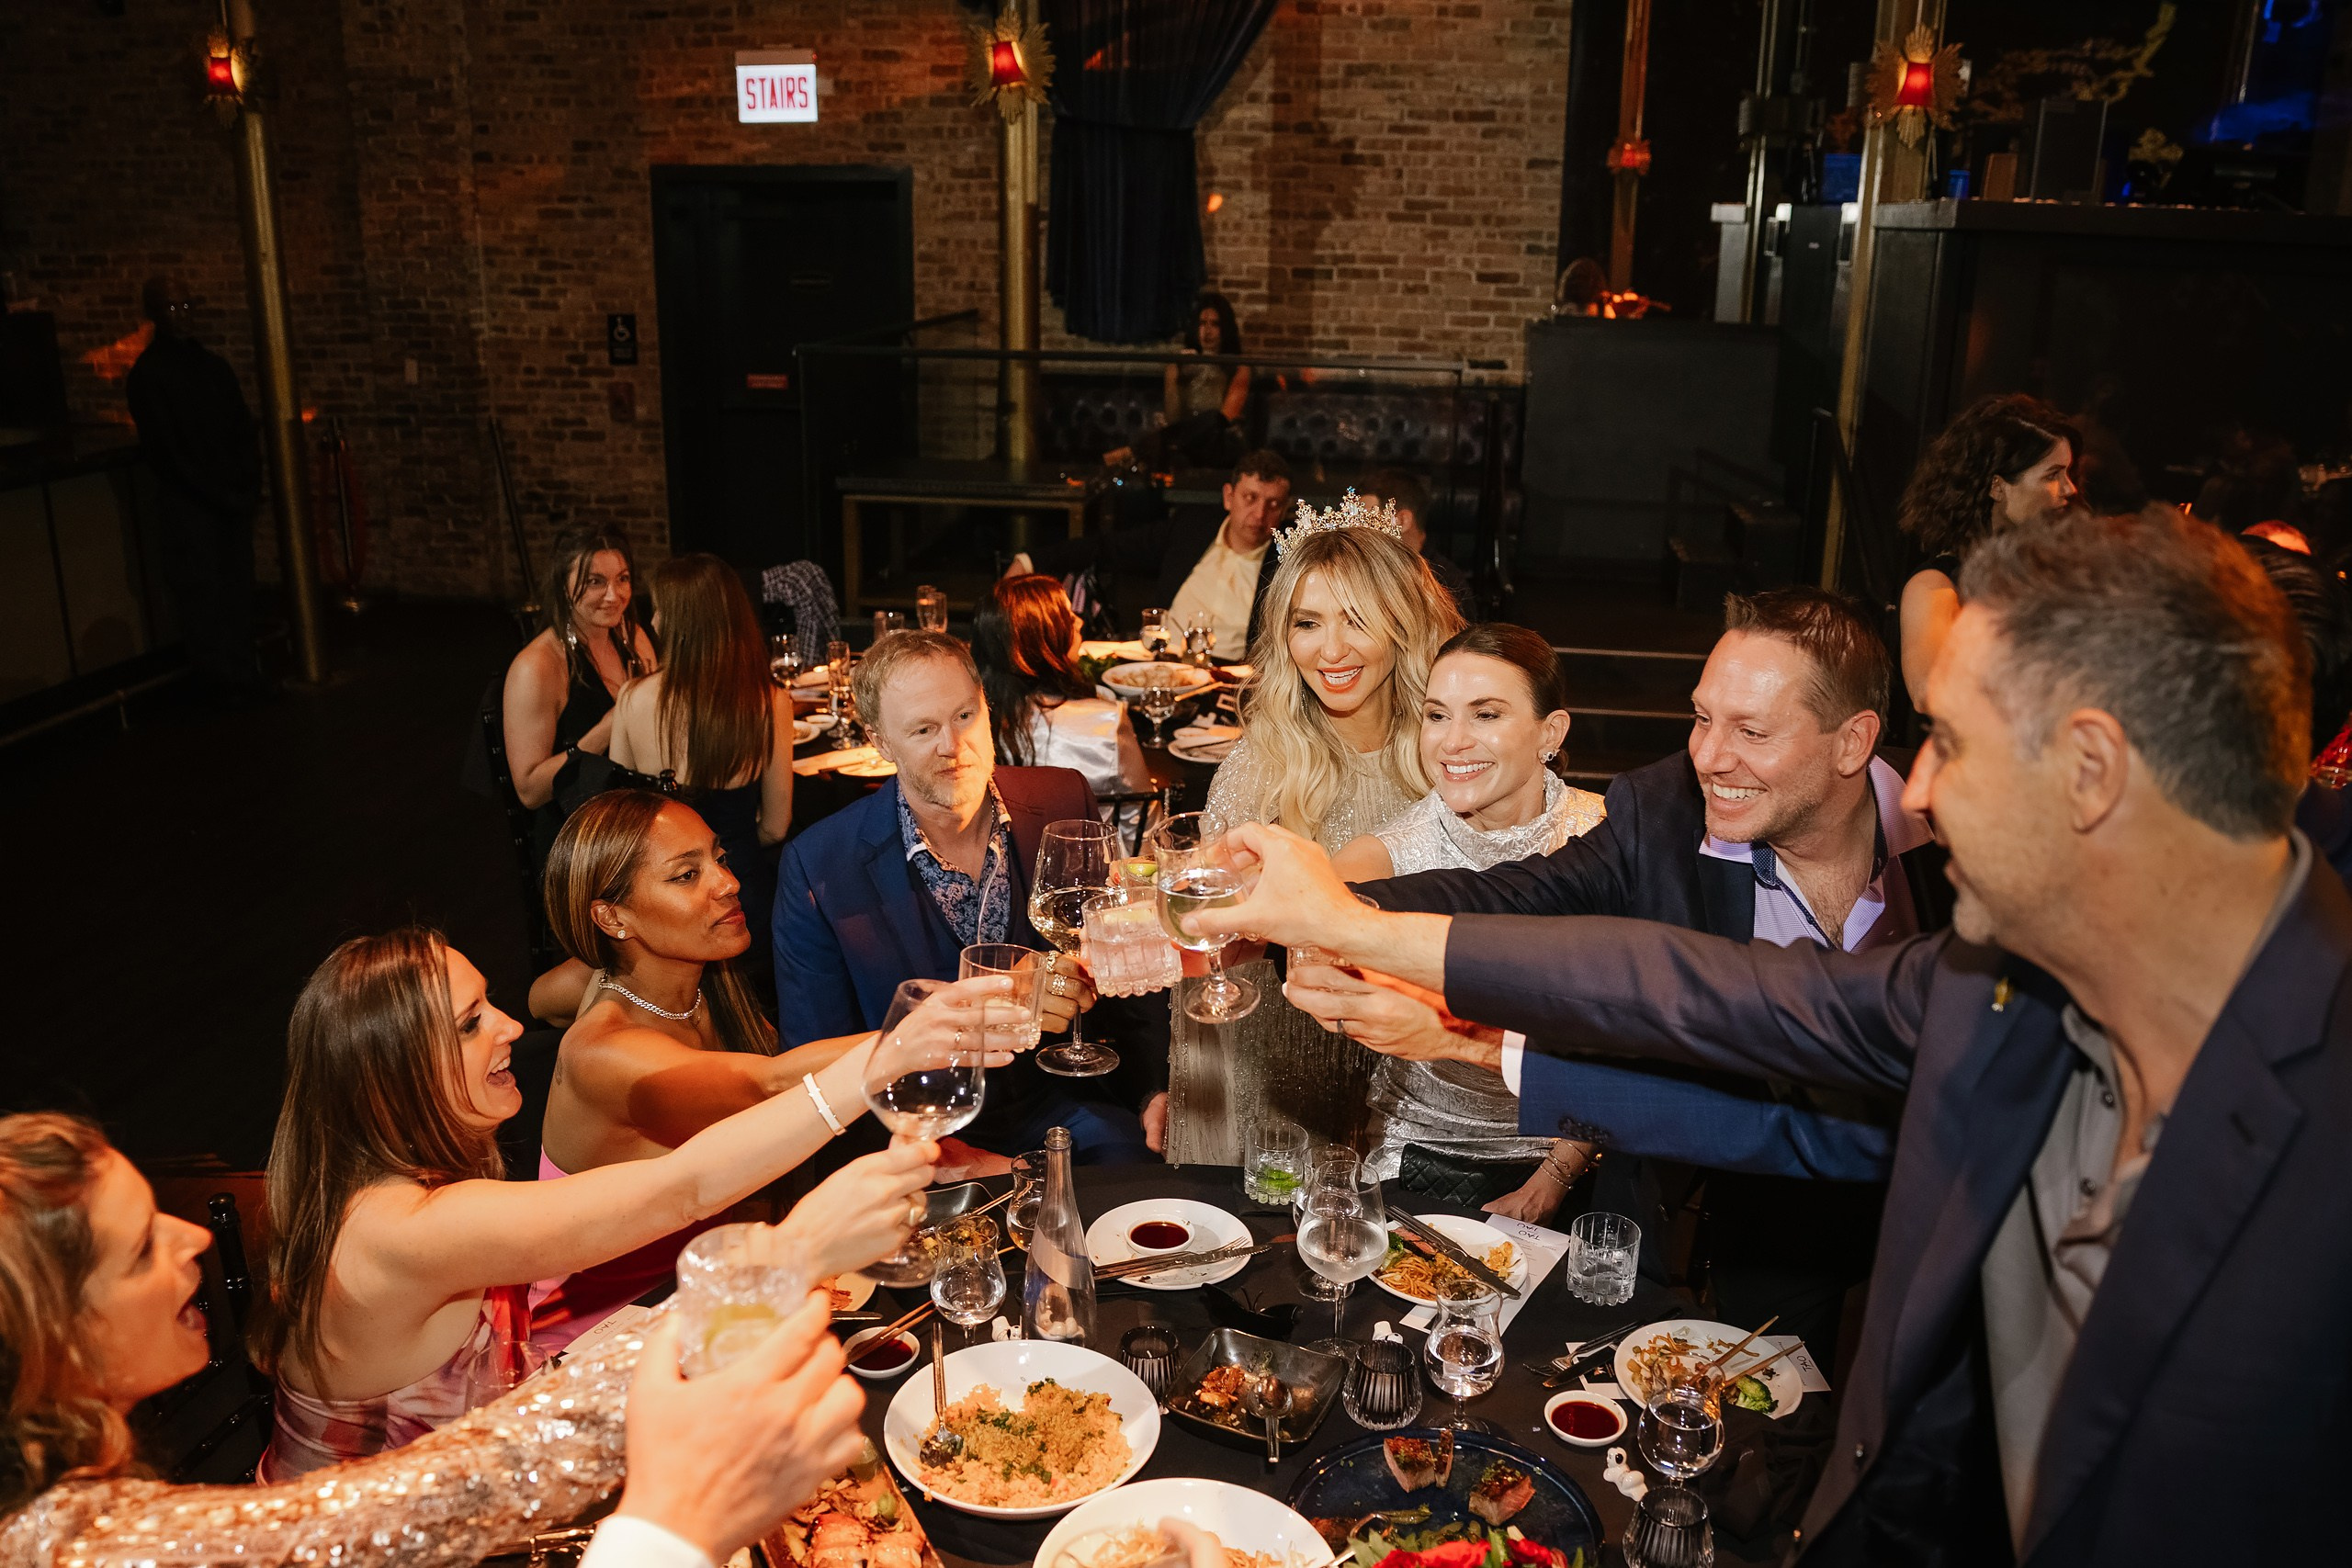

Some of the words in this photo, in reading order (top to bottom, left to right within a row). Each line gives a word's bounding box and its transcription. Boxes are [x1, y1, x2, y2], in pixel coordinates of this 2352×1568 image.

[745, 76, 808, 109] STAIRS
[1518, 1230, 1541, 1241] TAO
[594, 1320, 617, 1335] TAO
[1796, 1355, 1814, 1372] TAO
